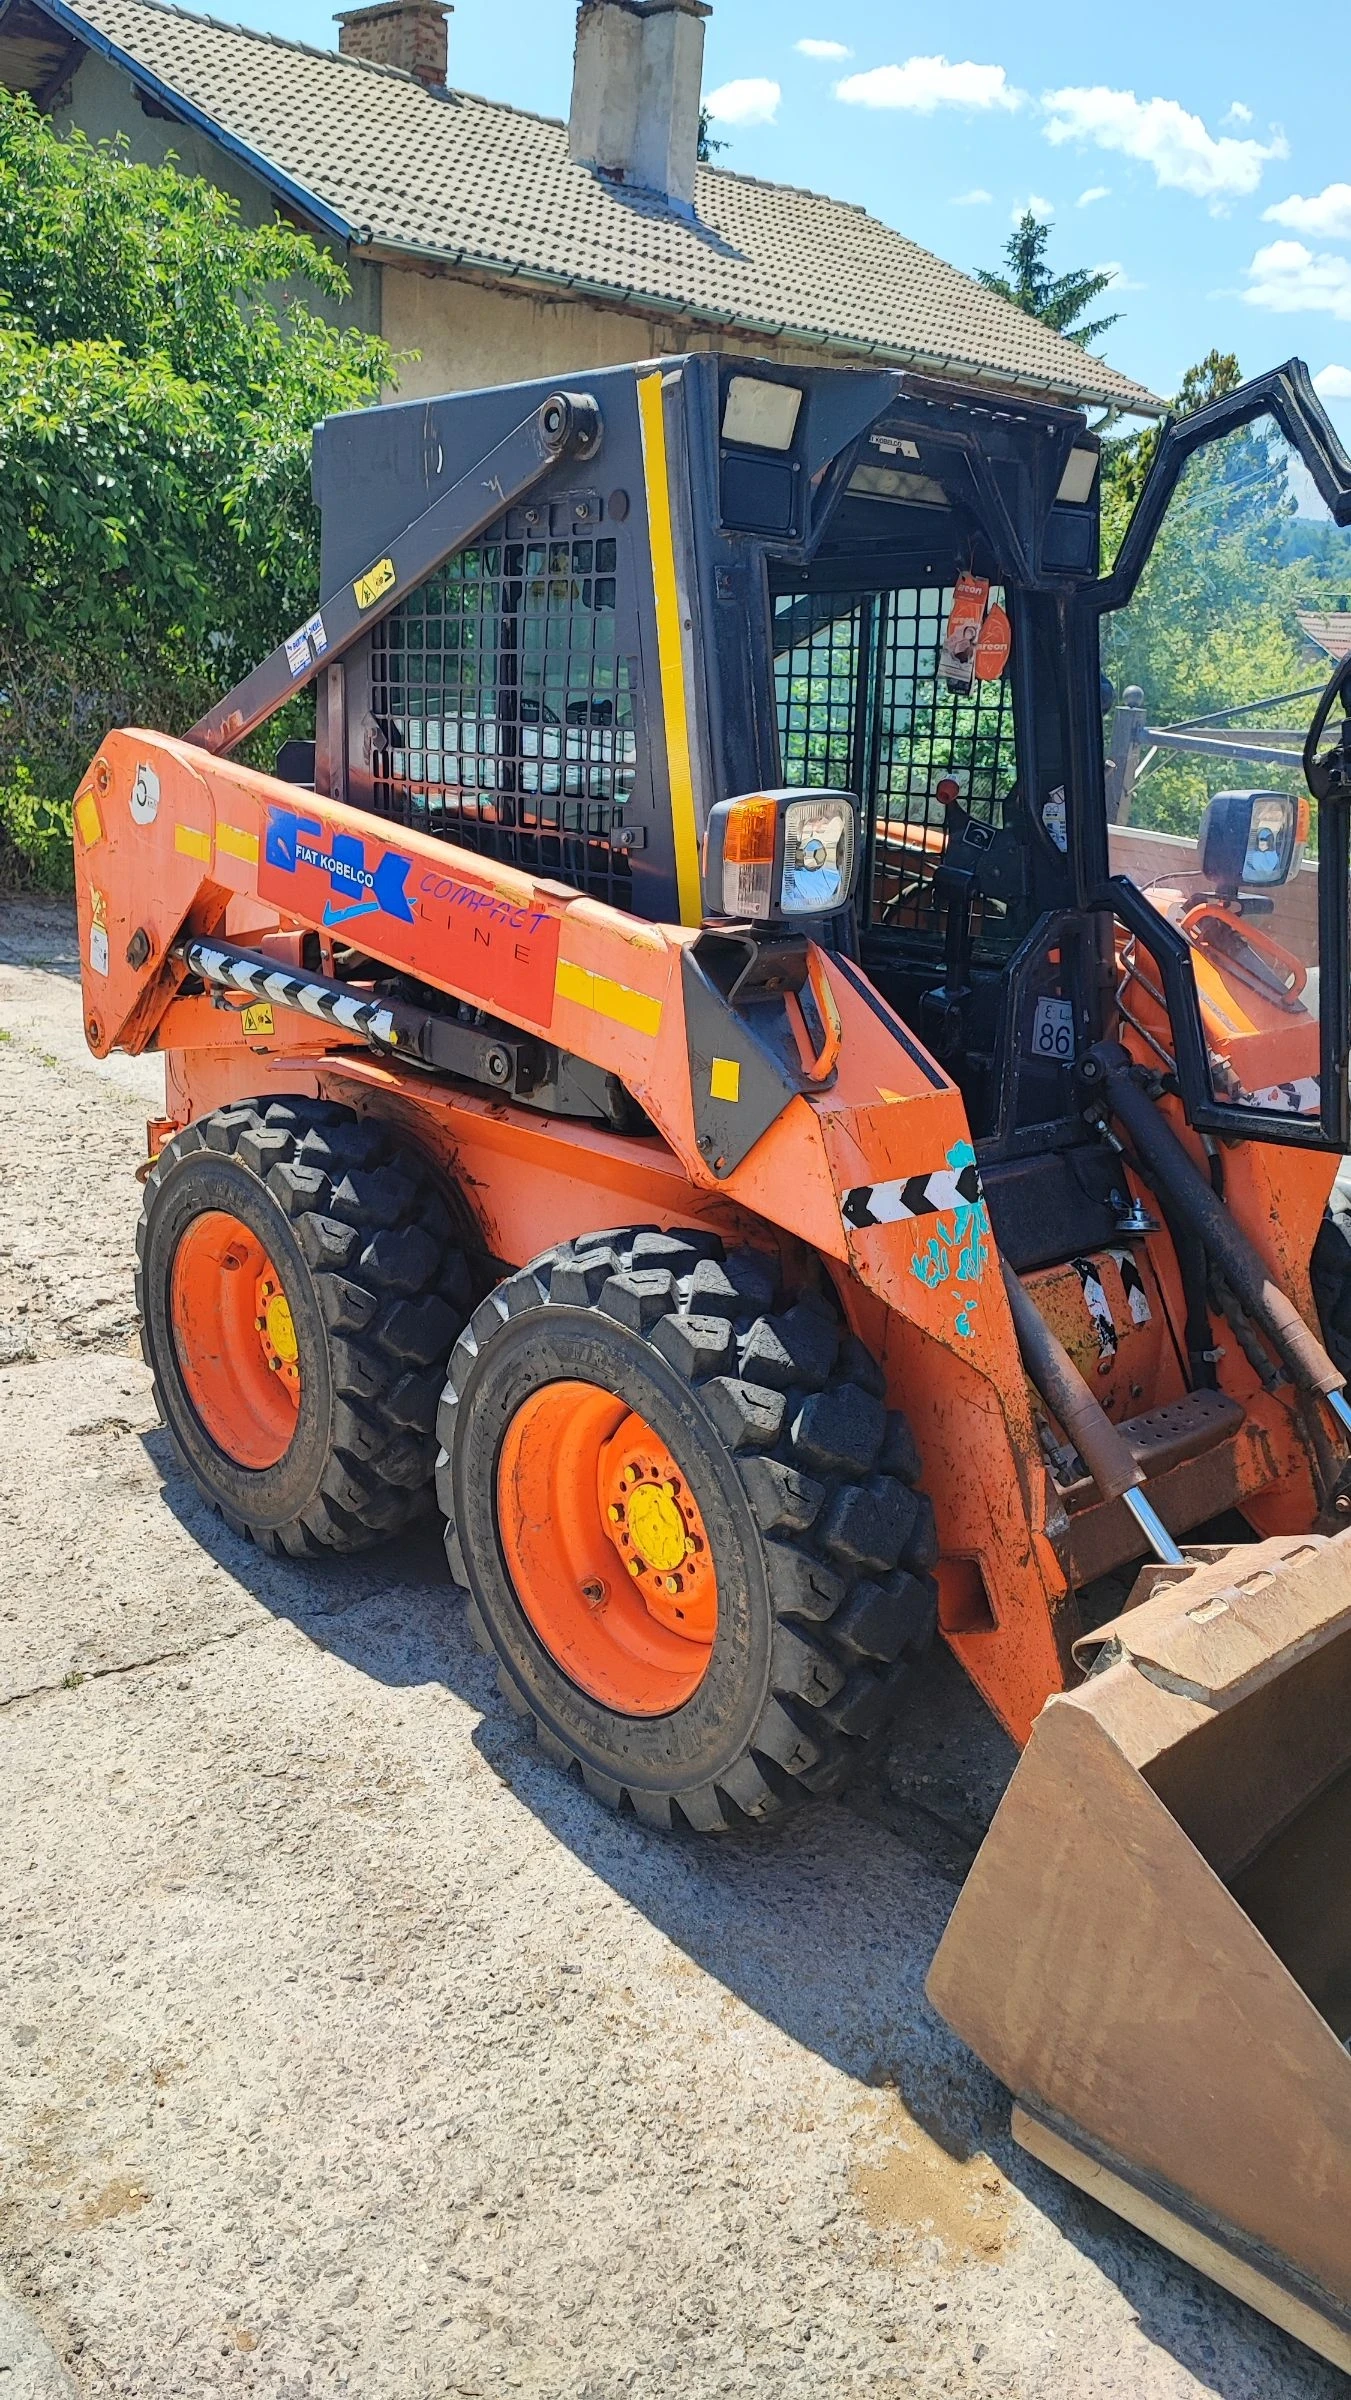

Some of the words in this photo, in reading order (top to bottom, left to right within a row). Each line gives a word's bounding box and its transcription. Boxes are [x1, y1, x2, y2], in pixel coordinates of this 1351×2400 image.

[136, 764, 147, 807] 5
[296, 844, 319, 864] FIAT
[320, 855, 374, 888] KOBELCO
[420, 872, 551, 935] COMPACT
[1039, 1022, 1071, 1054] 86
